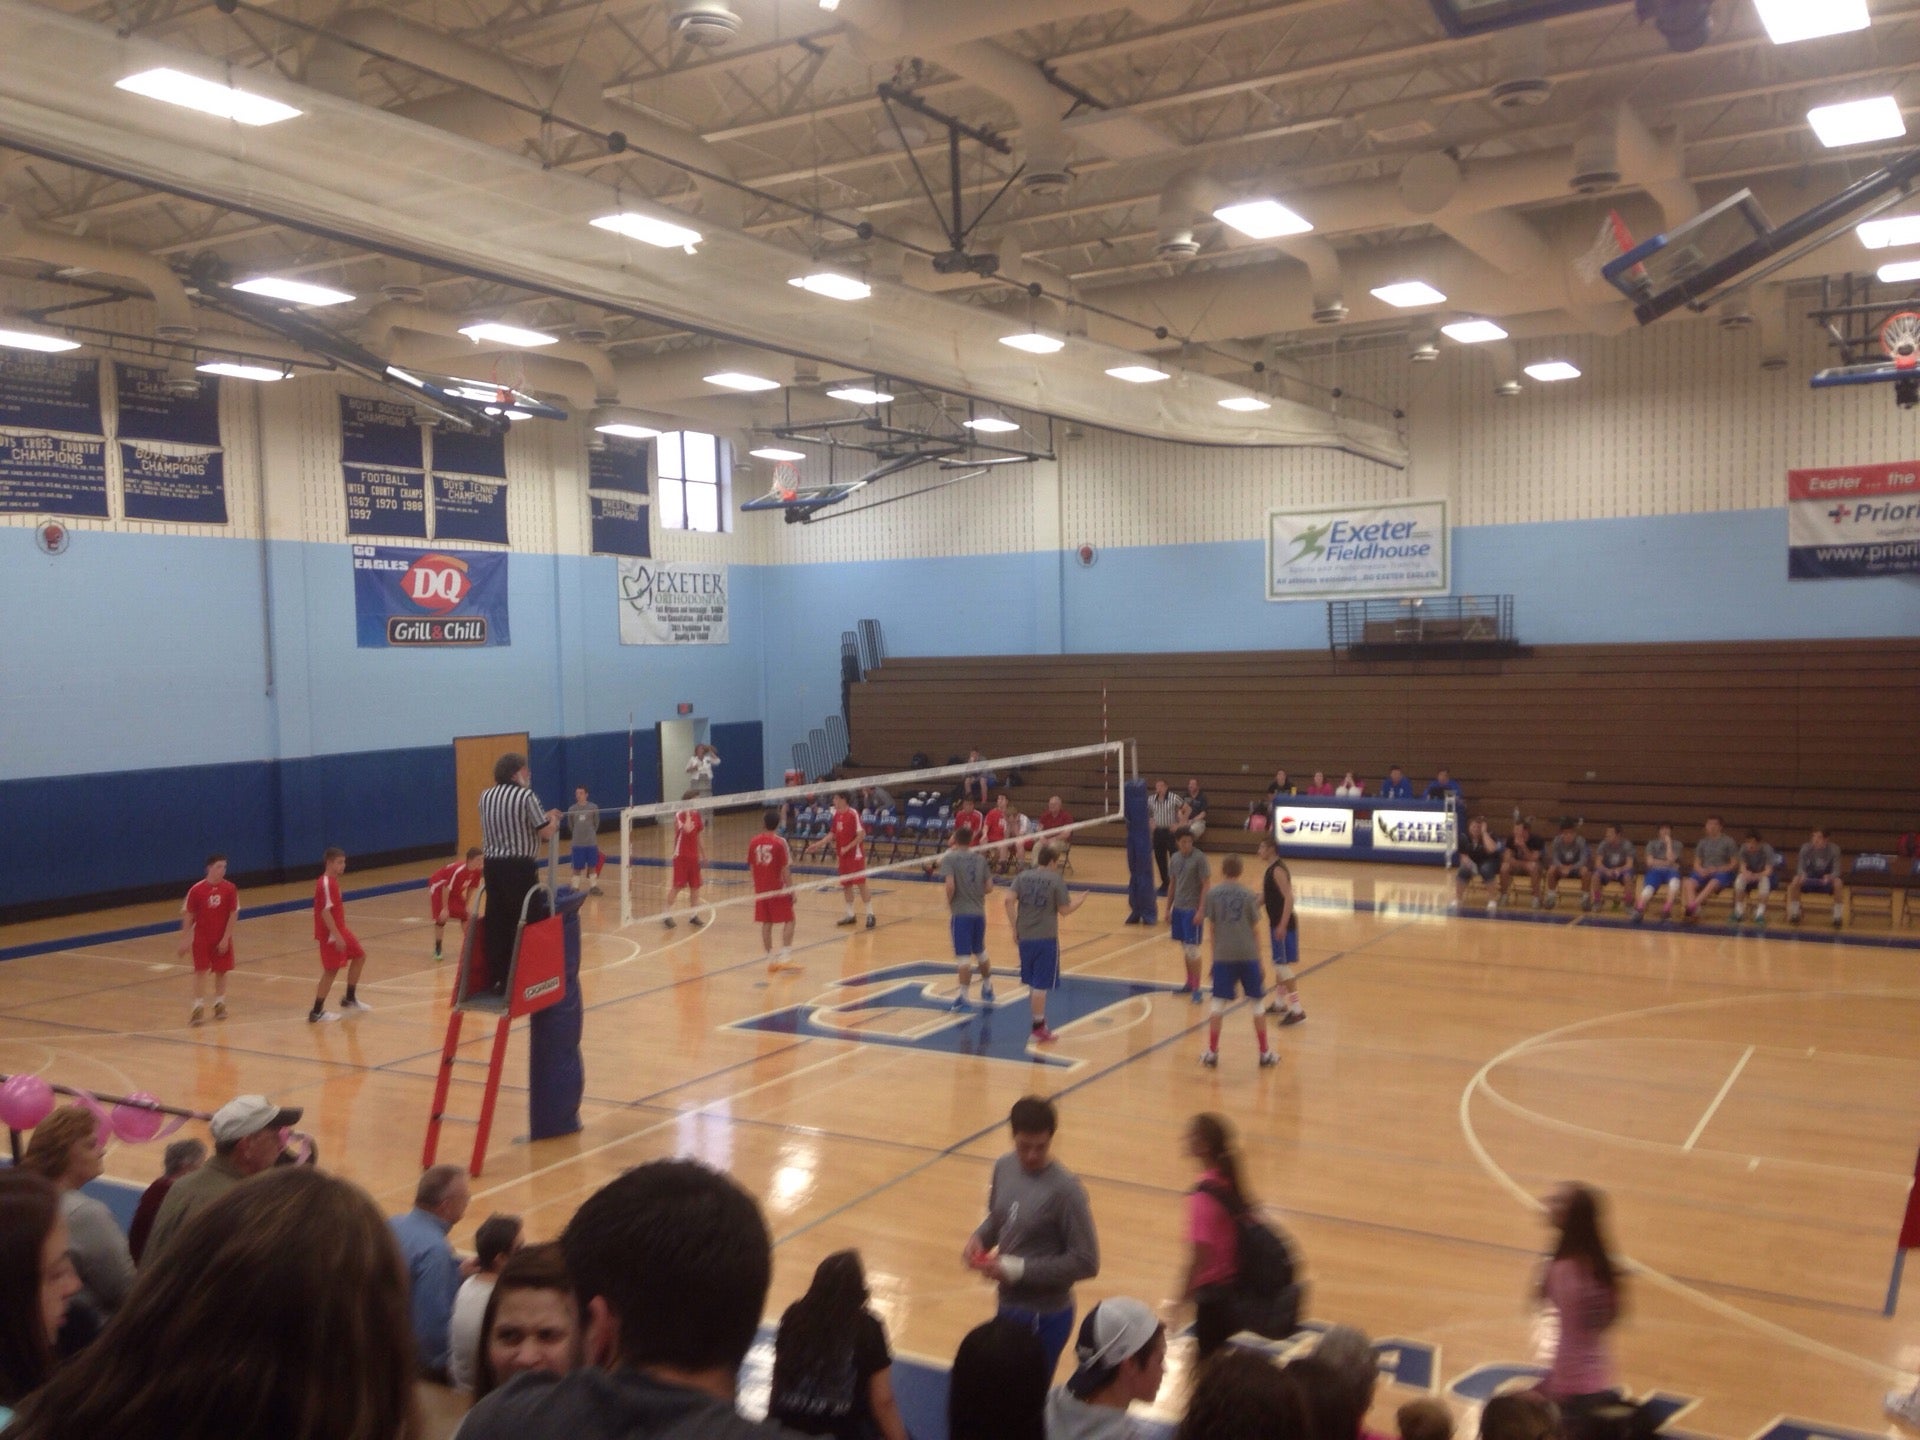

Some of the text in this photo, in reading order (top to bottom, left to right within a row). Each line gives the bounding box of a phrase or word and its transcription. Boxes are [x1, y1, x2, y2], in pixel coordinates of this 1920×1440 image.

[23, 438, 53, 449] CROSS
[60, 440, 100, 455] COUNTRY
[12, 448, 84, 465] CHAMPIONS
[141, 459, 206, 476] CHAMPIONS
[361, 472, 408, 486] FOOTBALL
[442, 479, 498, 495] BOYS TENNIS
[1809, 471, 1916, 491] Exeter the
[347, 484, 423, 499] INTER COUNTY CHAMPS
[448, 489, 494, 504] CHAMPIONS
[375, 498, 398, 510] 1970
[350, 509, 371, 520] 1997
[1330, 519, 1418, 544] Exeter
[353, 545, 376, 557] GO
[1326, 542, 1430, 561] Fieldhouse
[354, 558, 409, 571] EAGLES
[412, 567, 462, 604] DQ
[657, 571, 724, 594] EXETER
[1299, 820, 1347, 834] PEPSI
[1398, 830, 1449, 843] EAGLE
[756, 843, 773, 865] 15
